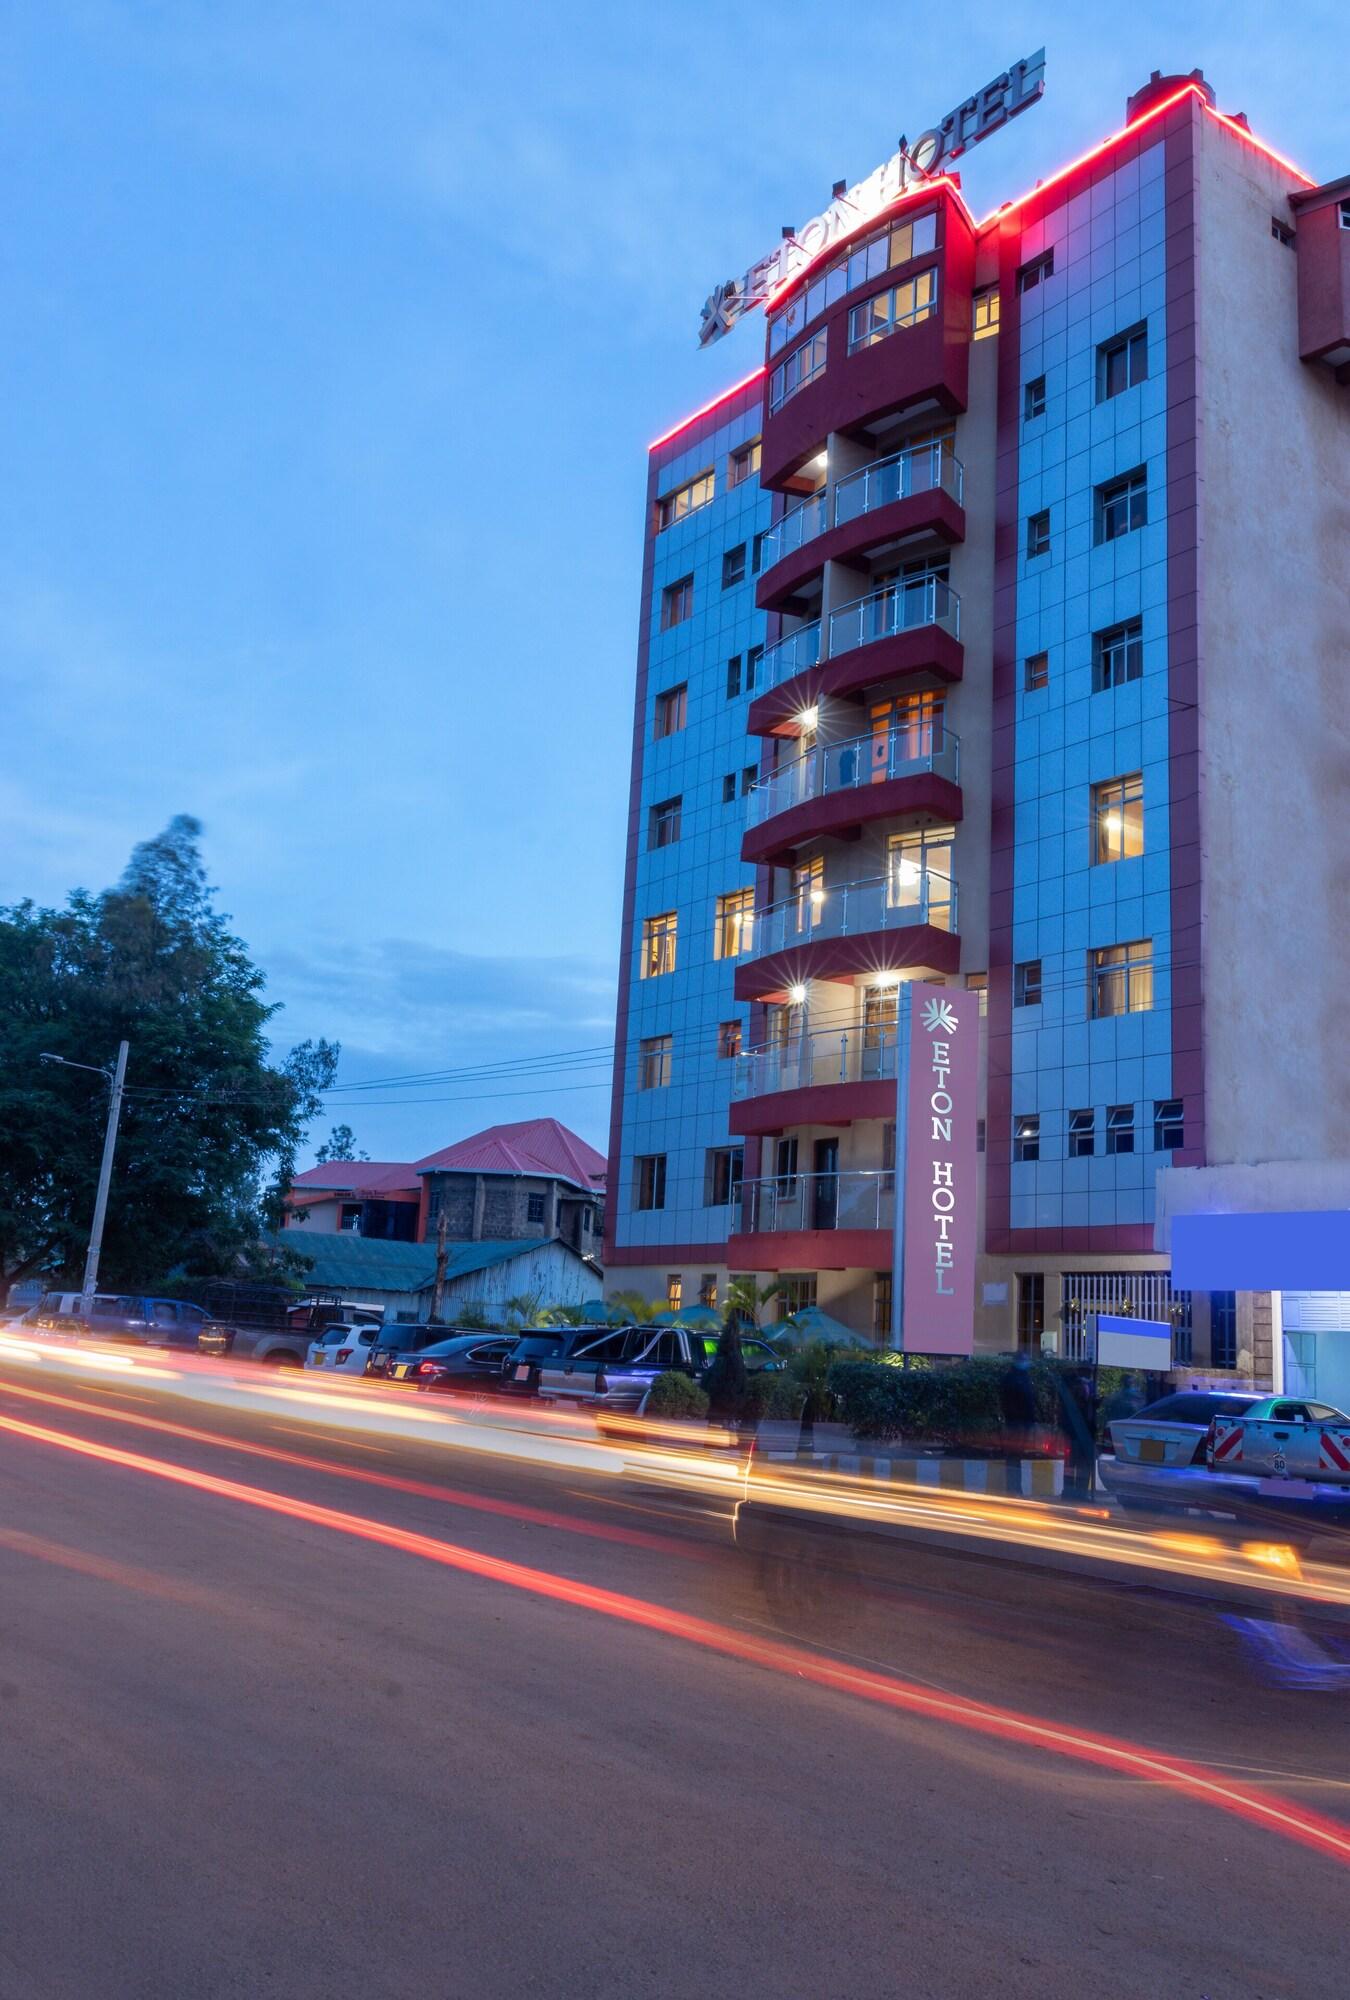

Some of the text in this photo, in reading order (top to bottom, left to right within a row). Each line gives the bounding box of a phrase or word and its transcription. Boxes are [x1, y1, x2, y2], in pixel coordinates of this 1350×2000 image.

[931, 1041, 955, 1296] ETON HOTEL
[1274, 1459, 1286, 1469] 80
